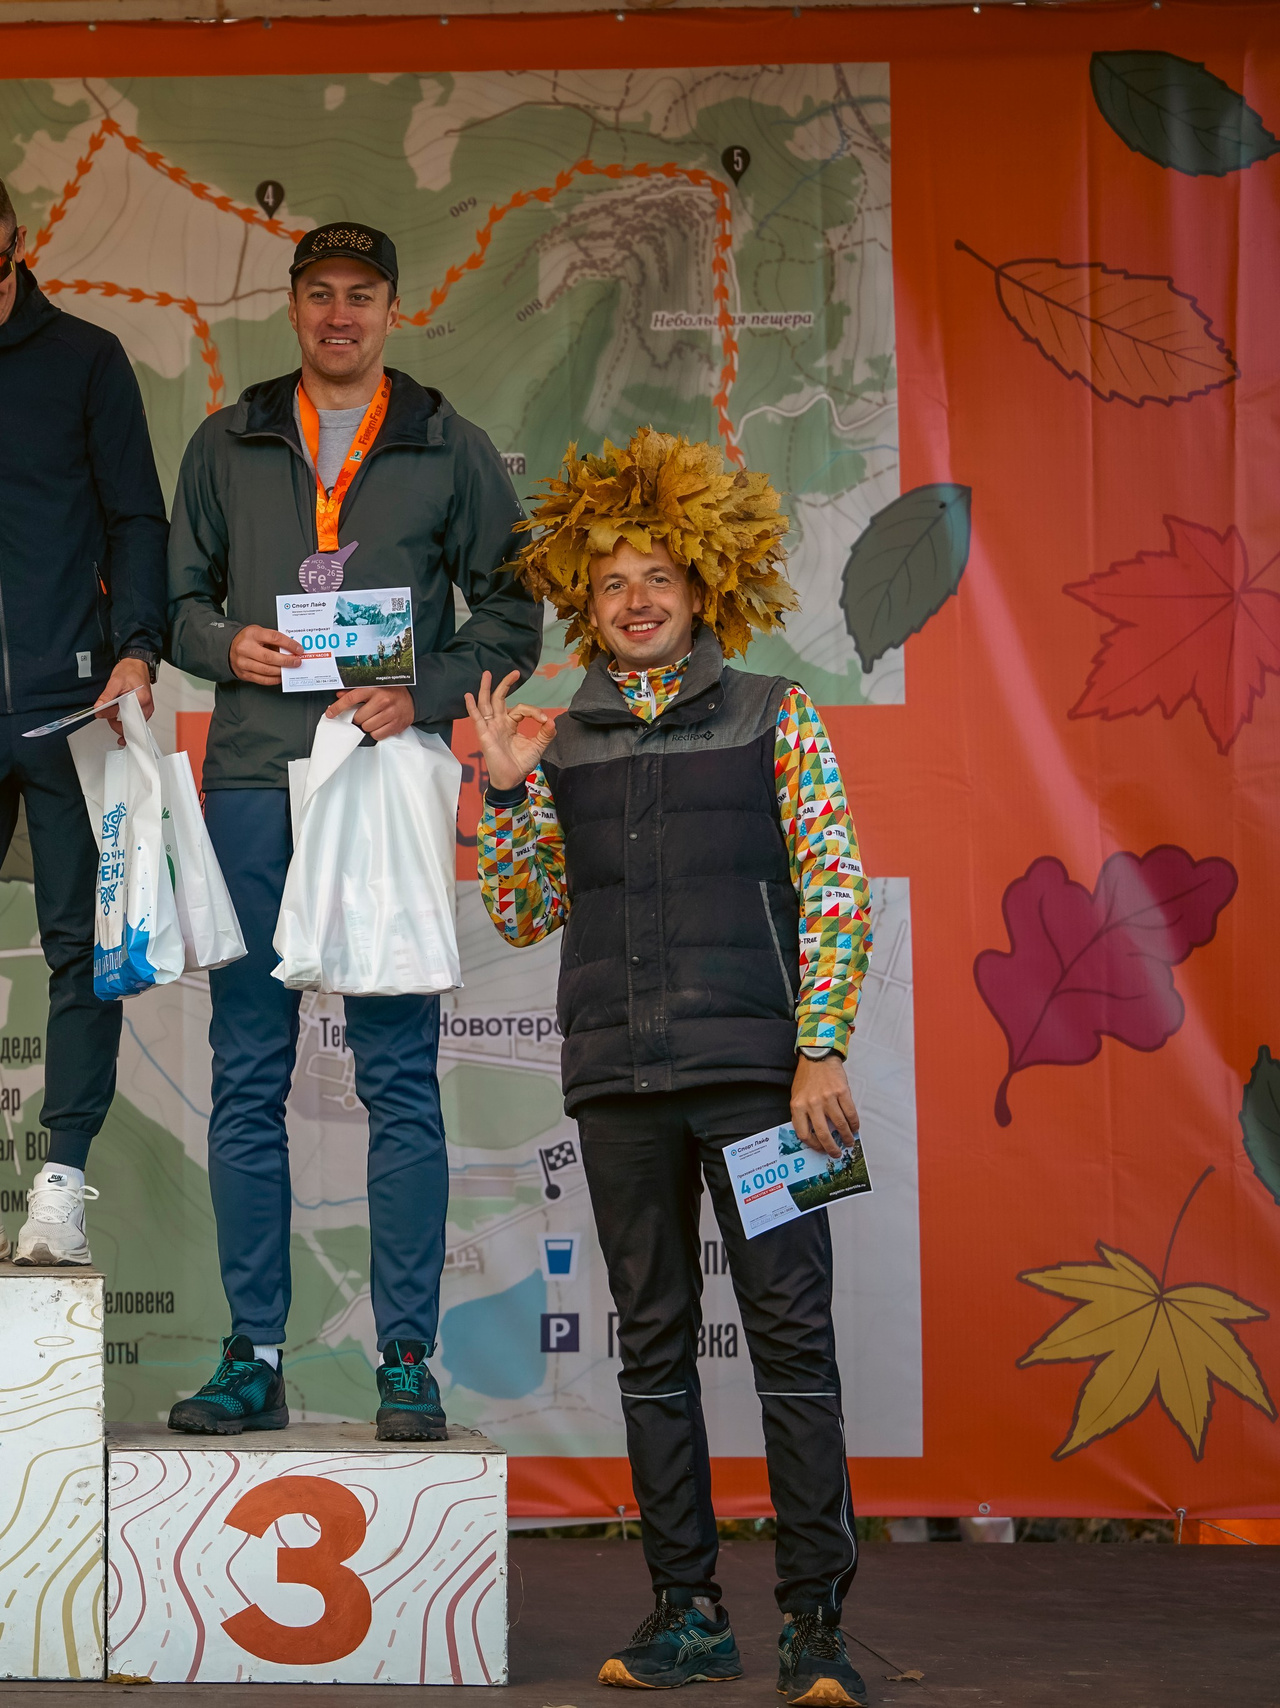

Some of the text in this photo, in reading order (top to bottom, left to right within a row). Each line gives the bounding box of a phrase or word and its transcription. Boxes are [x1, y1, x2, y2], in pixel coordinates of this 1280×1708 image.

[733, 149, 743, 171] 5
[264, 185, 273, 206] 4
[751, 313, 812, 329] пещера
[308, 569, 336, 585] Fe 26
[672, 733, 704, 742] RedFox
[825, 890, 852, 899] O-TRAIL
[0, 1036, 42, 1064] деда
[737, 1143, 754, 1153] Спорт
[754, 1137, 770, 1147] Лайф
[105, 1291, 174, 1314] еловека
[220, 1475, 372, 1666] 3
